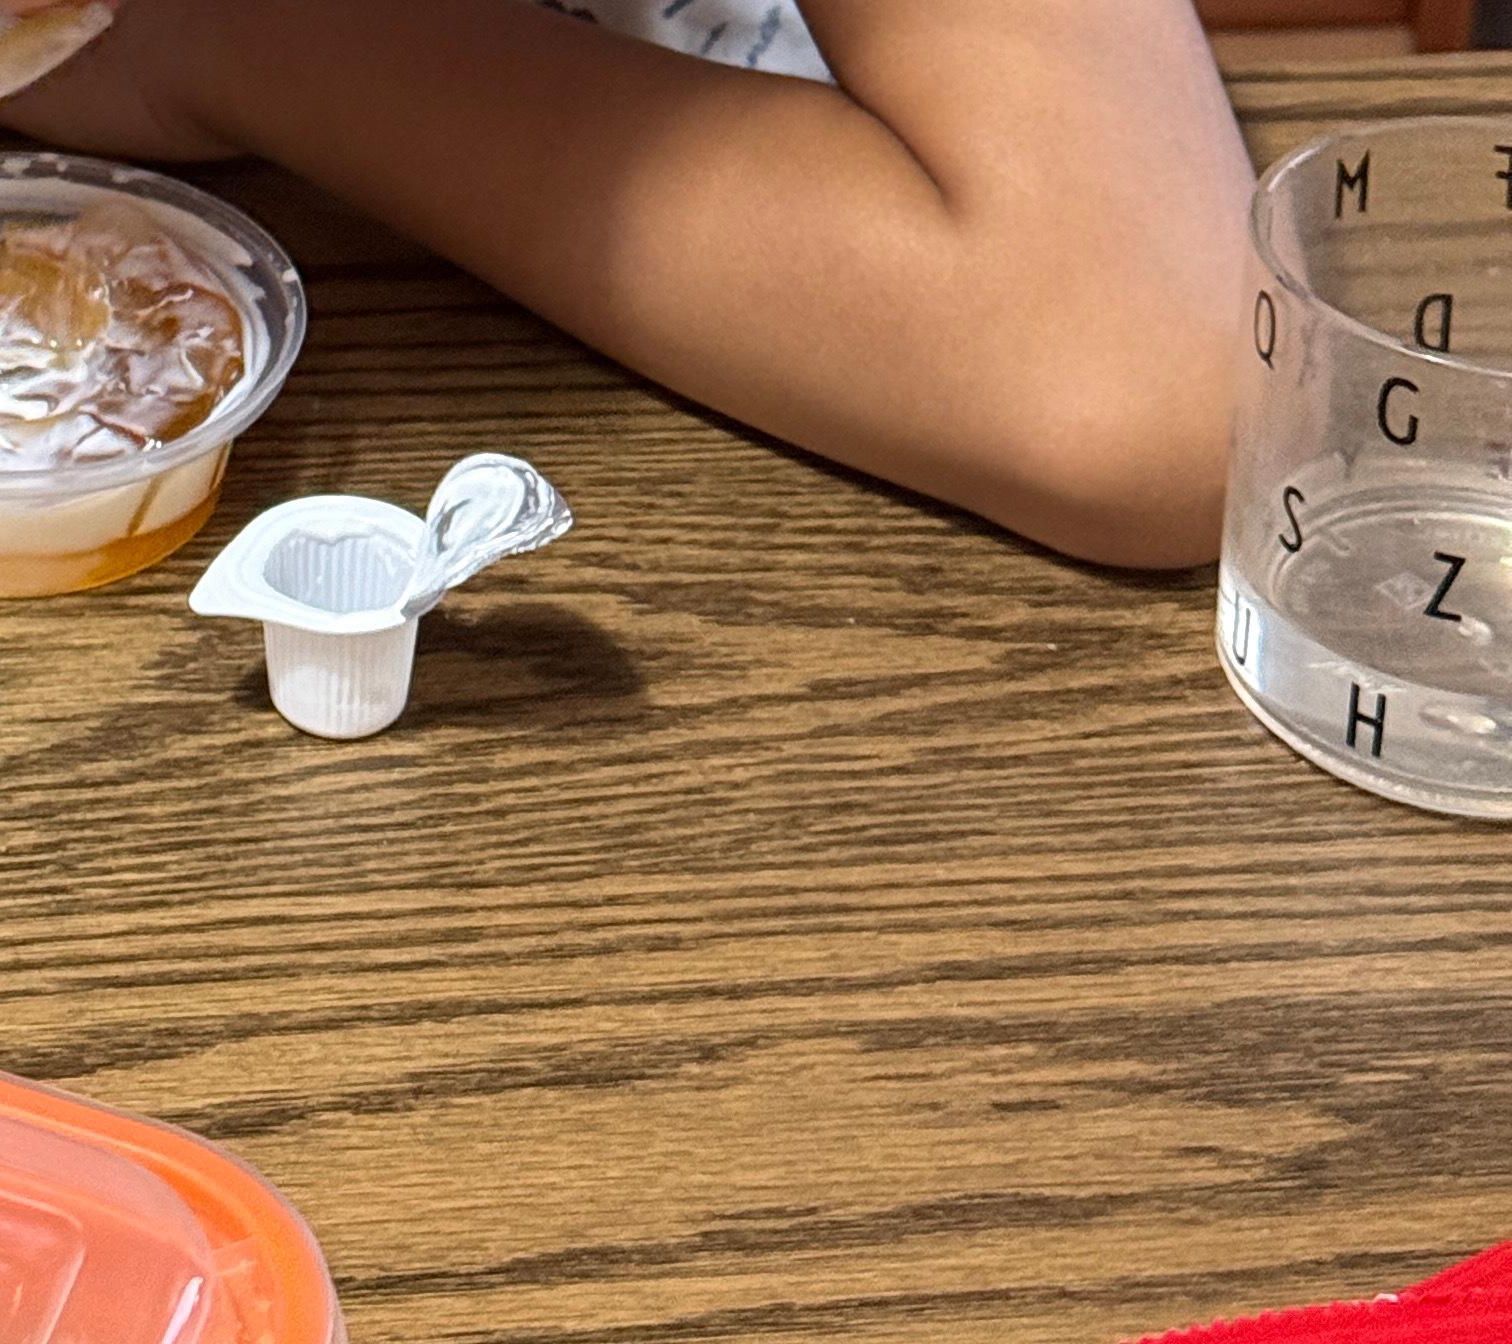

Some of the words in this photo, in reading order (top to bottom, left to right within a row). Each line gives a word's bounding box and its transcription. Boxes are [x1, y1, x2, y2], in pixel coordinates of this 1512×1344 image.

[1334, 151, 1371, 219] M
[1253, 289, 1276, 370] Q
[1376, 376, 1420, 447] G
[1278, 485, 1306, 555] S
[1422, 550, 1467, 623] Z
[1344, 682, 1388, 759] H
